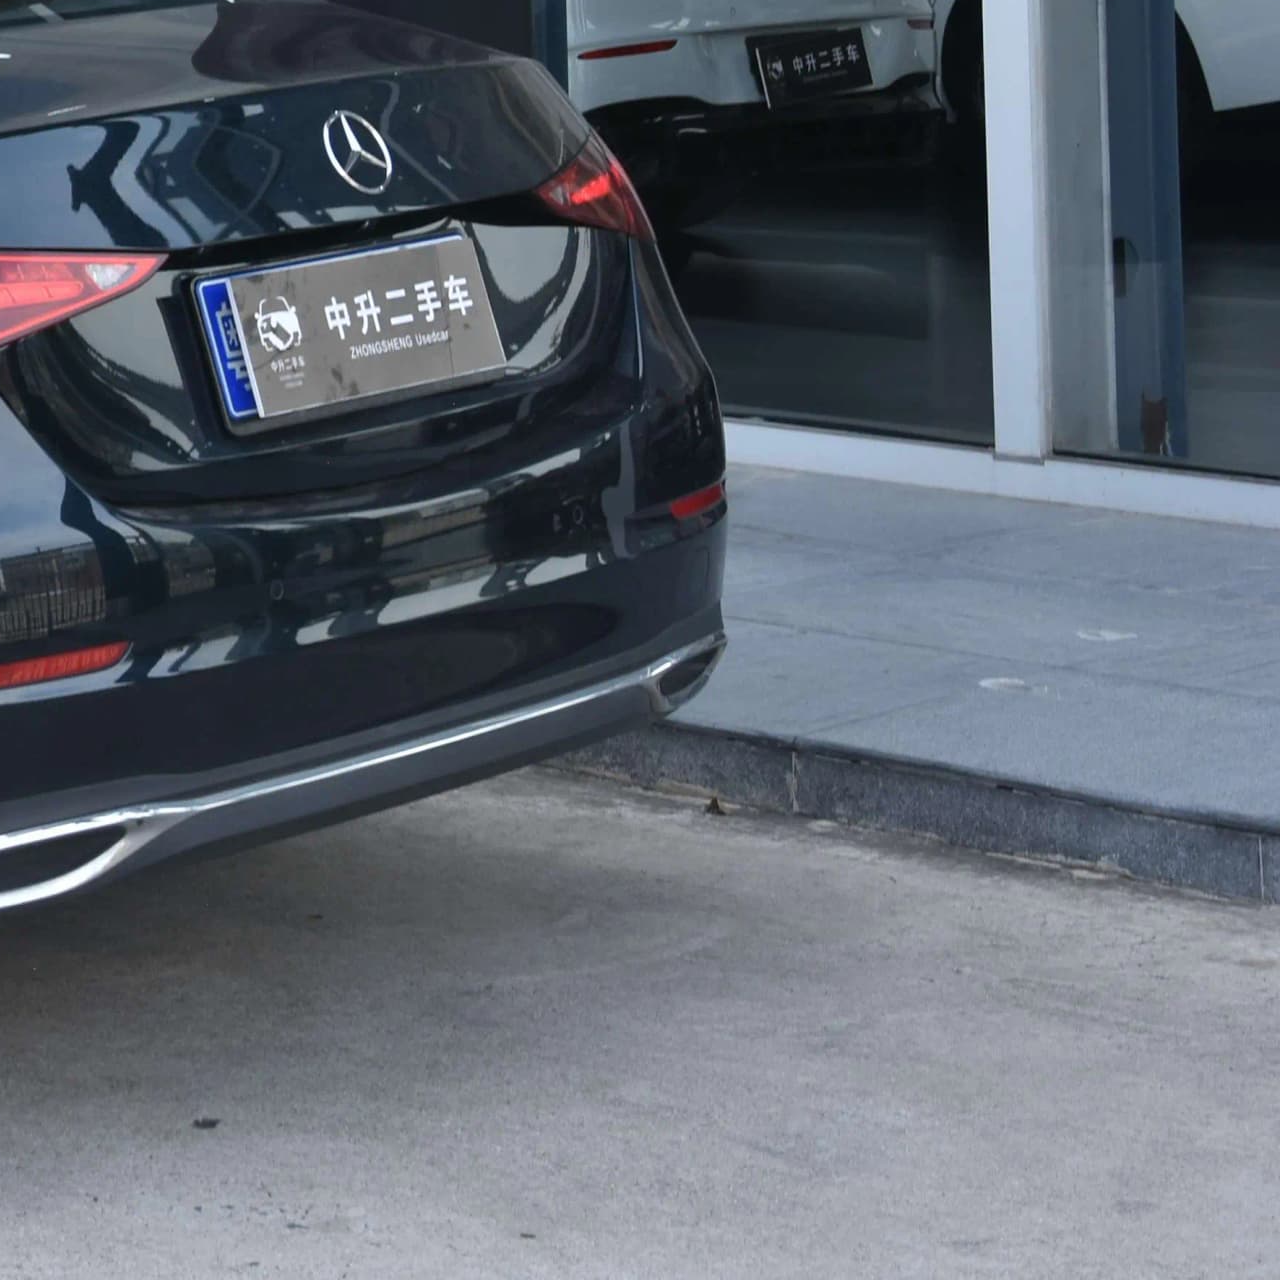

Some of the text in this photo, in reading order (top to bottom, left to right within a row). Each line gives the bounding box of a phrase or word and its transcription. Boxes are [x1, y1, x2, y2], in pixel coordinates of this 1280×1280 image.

[792, 43, 861, 76] 中升二手车
[324, 274, 474, 340] 中升二手车
[349, 329, 450, 360] ZHONGSHENG Usedcar
